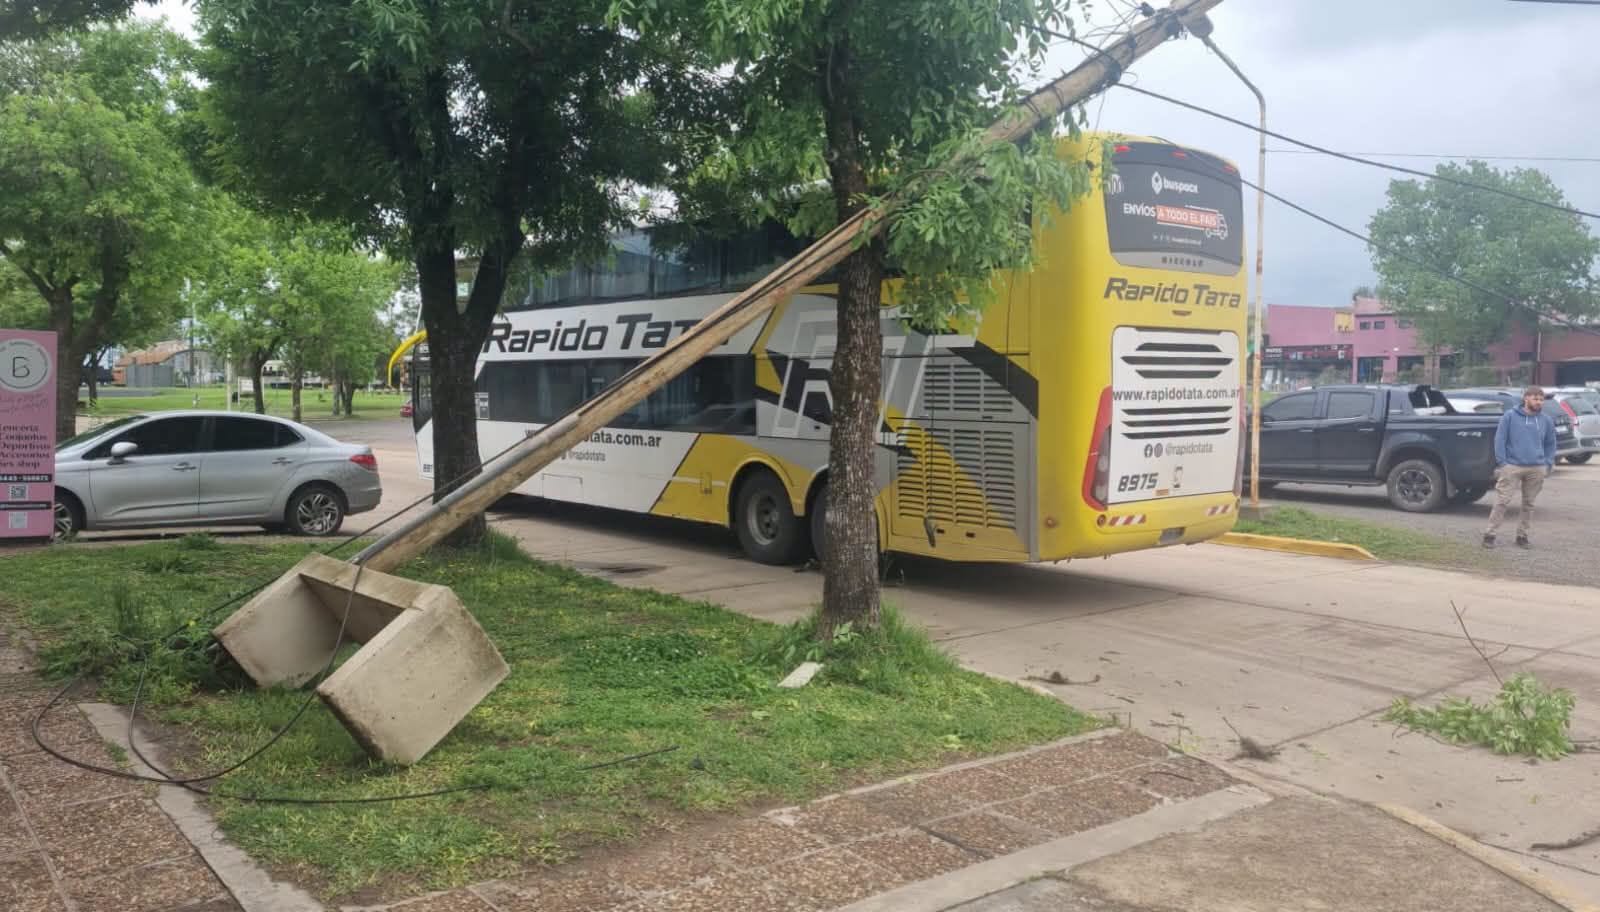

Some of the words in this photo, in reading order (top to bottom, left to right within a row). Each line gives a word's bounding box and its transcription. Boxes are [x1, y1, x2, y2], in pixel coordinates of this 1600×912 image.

[1166, 207, 1189, 222] TODO
[616, 313, 730, 350] Tat
[1113, 384, 1240, 402] www.rapidotata.com.ar
[1165, 442, 1213, 457] @rapidotata
[1117, 472, 1159, 492] 8975
